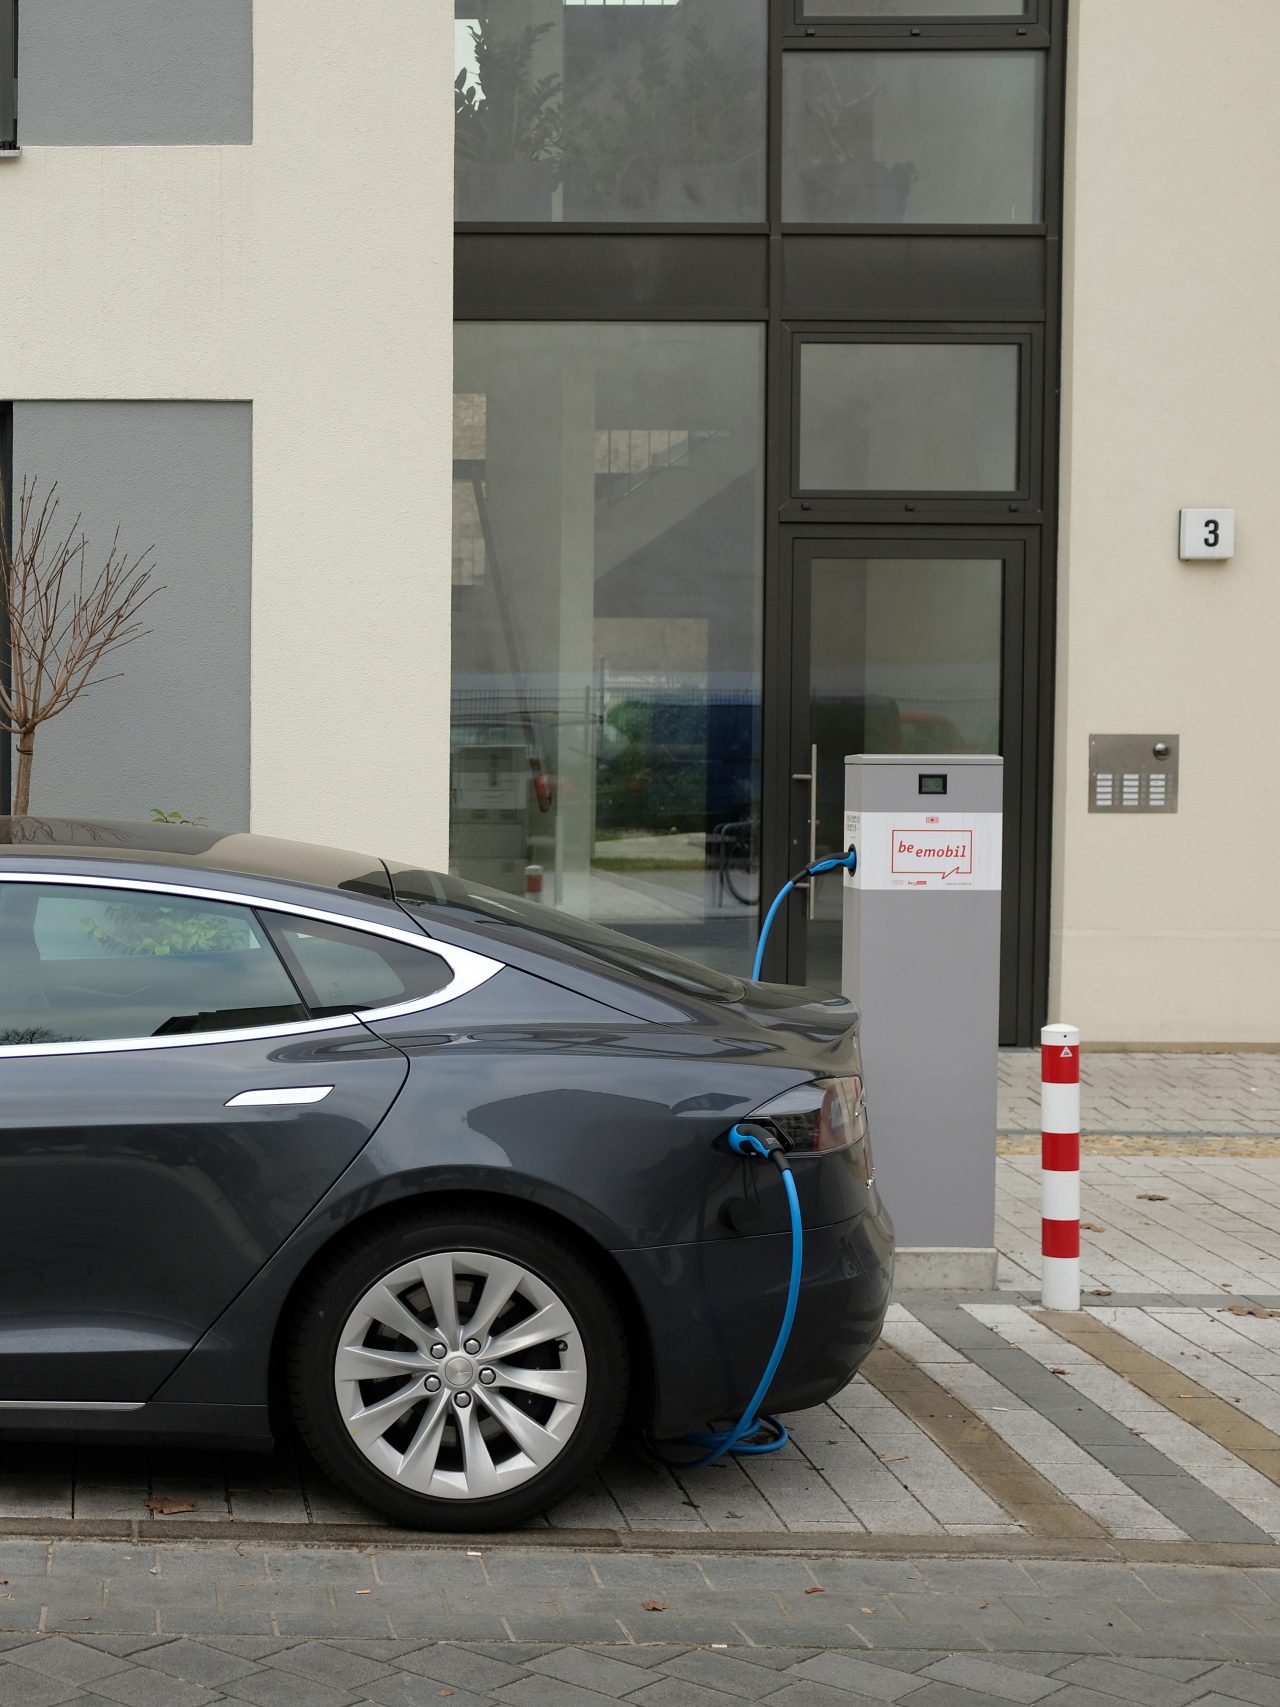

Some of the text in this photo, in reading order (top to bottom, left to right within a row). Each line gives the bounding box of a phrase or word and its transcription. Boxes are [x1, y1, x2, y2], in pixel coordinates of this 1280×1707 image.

[1203, 519, 1220, 548] 3
[898, 840, 967, 858] be emobil
